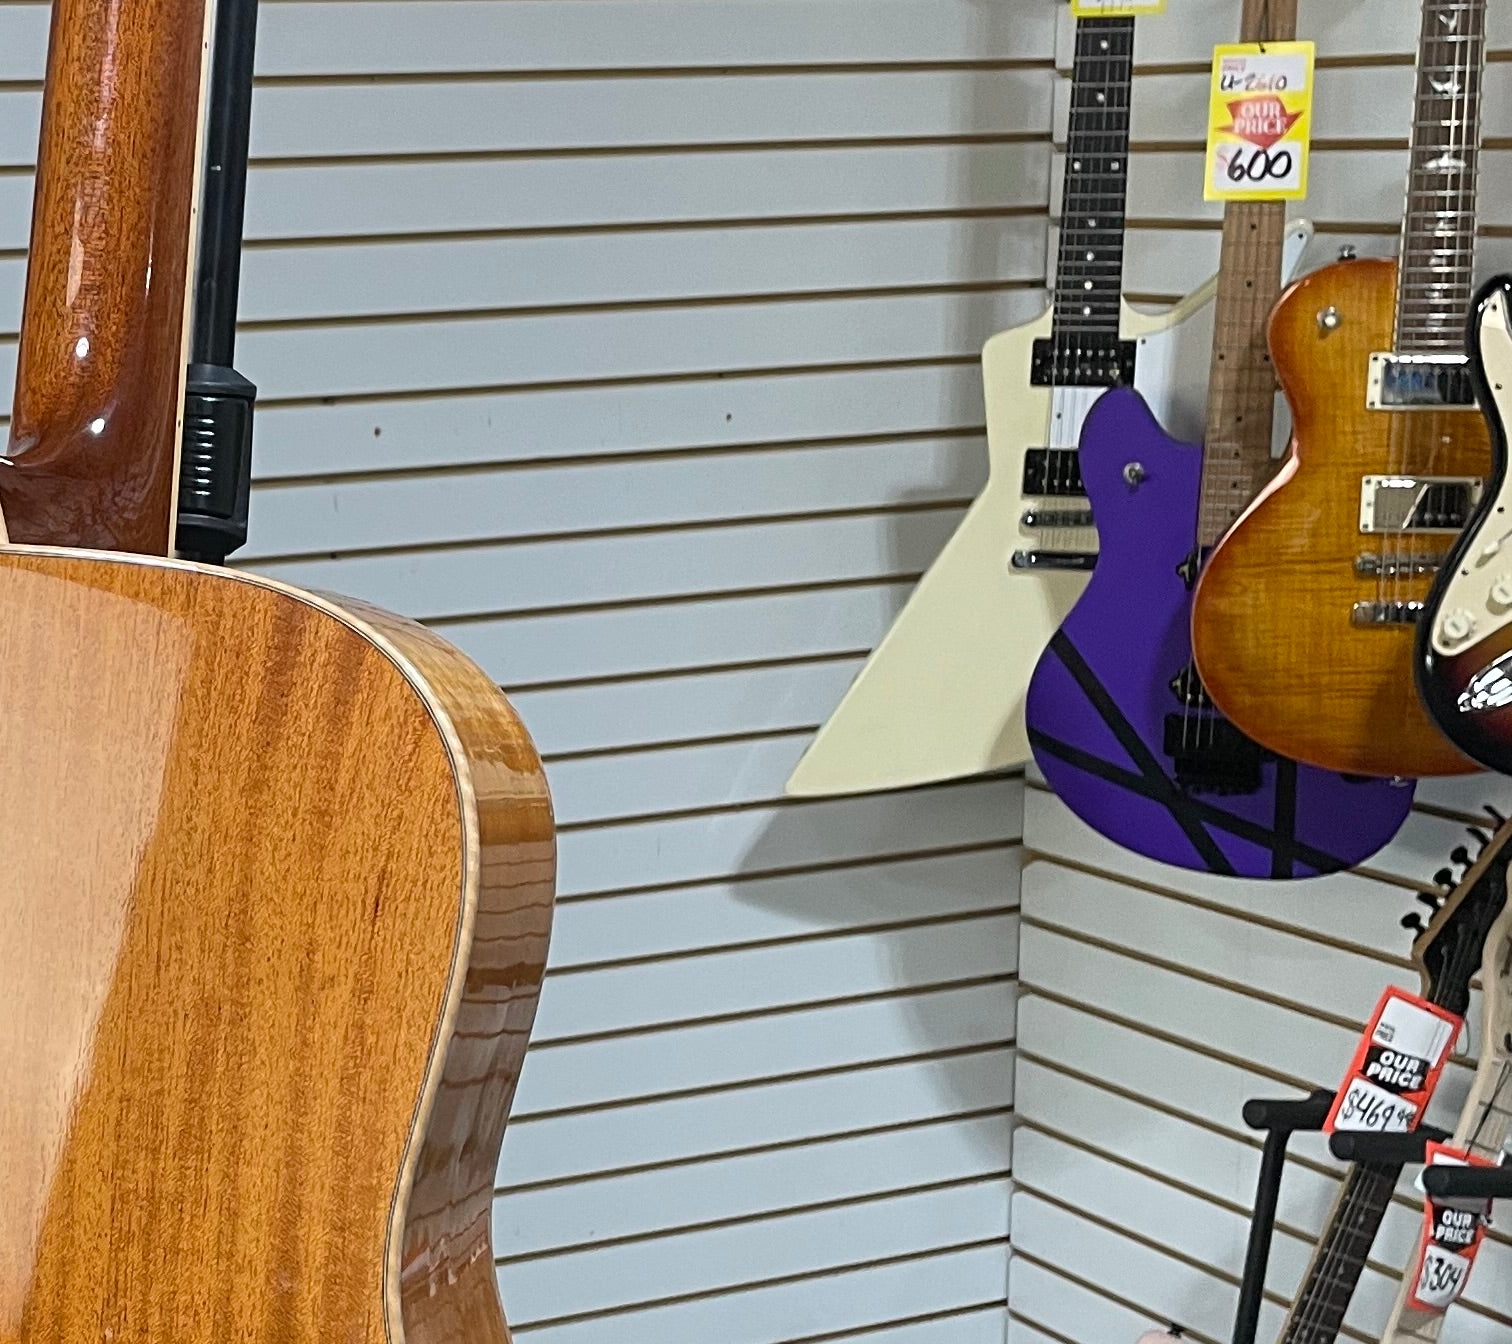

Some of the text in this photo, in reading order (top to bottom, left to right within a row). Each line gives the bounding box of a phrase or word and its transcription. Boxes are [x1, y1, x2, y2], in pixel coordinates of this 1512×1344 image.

[1241, 101, 1281, 118] OUR
[1234, 116, 1288, 136] PRICE
[1379, 1050, 1421, 1074] OUR
[1366, 1061, 1424, 1091] PRICE
[1442, 1209, 1473, 1229] OUR
[1435, 1223, 1475, 1245] PRICE
